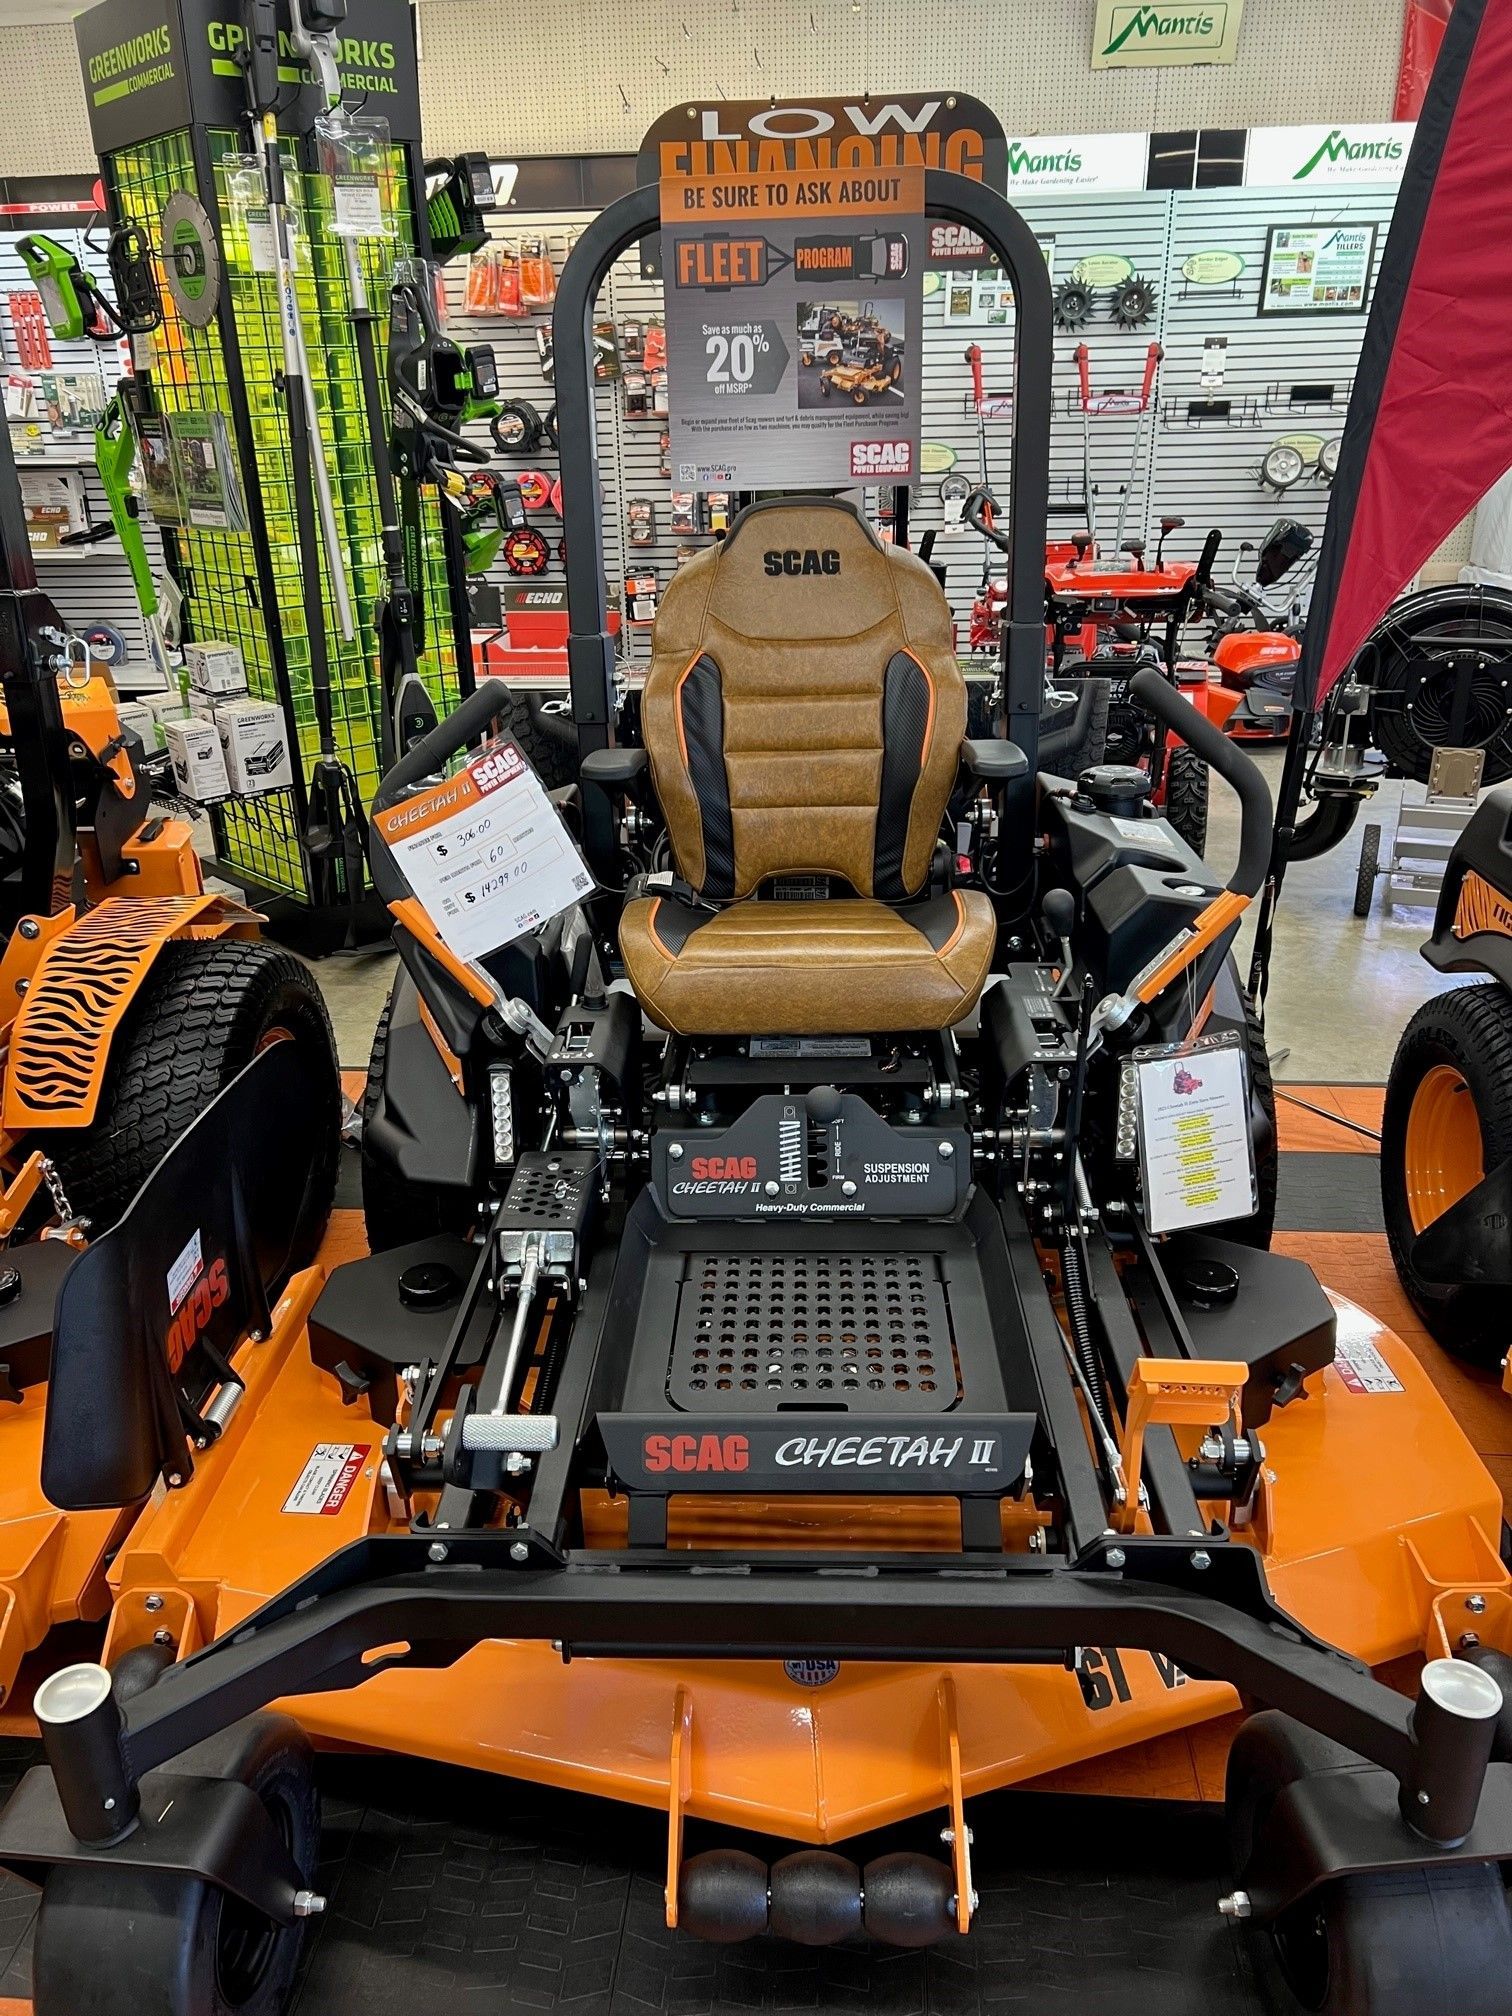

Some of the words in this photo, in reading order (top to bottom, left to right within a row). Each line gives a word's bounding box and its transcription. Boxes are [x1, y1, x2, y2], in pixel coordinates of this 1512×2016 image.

[1101, 5, 1214, 55] Mantis
[88, 24, 171, 84] GREENWORKS
[127, 62, 175, 93] COMMERCIAL
[702, 101, 941, 140] LOW
[1292, 130, 1402, 180] Mantis
[684, 187, 705, 209] BE
[712, 184, 759, 208] SURE
[765, 183, 789, 206] TO
[795, 181, 832, 205] ASK
[839, 179, 901, 203] ABOUT
[29, 203, 79, 212] POWER
[1321, 230, 1366, 249] Mantis
[931, 247, 952, 256] POWER
[952, 246, 984, 255] EQUIPMENT
[679, 241, 764, 284] FLEET
[796, 246, 852, 269] PROGRAM
[702, 324, 720, 336] Save
[721, 326, 730, 335] as
[731, 324, 752, 335] much
[753, 325, 762, 334] as
[705, 334, 770, 383] 20%
[715, 383, 725, 395] off
[746, 416, 757, 424] Scag
[811, 421, 827, 430] qualify
[852, 443, 910, 465] SCAG
[697, 463, 737, 473] www.SCAG.pro
[853, 465, 874, 474] POWER
[875, 464, 909, 473] EQUIPMENT
[41, 506, 62, 514] ECHO
[763, 550, 840, 576] SCAG
[525, 592, 563, 604] ECHO
[207, 651, 234, 659] greenworks
[237, 712, 276, 724] GREENWORKS
[185, 729, 215, 739] GREENWORKS
[472, 747, 519, 786] SCAG
[480, 779, 499, 794] POWER
[387, 788, 459, 832] CHEETAH
[436, 844, 448, 857] $
[456, 819, 491, 847] 306.00
[489, 846, 504, 863] 60
[464, 891, 476, 903] $
[691, 1156, 757, 1180] SCAG
[863, 1162, 930, 1174] SUSPENSION
[864, 1174, 929, 1184] ADJUSTMENT
[673, 1181, 748, 1195] CHEETAH
[750, 1182, 761, 1193] II
[755, 1202, 809, 1213] Heavy-Duty
[810, 1202, 865, 1212] Commercial
[644, 1434, 749, 1472] SCAG
[774, 1436, 963, 1469] CHEETAH
[968, 1440, 996, 1465] II
[326, 1465, 357, 1507] DANGER
[805, 1660, 836, 1670] USA
[1075, 1647, 1132, 1711] 61
